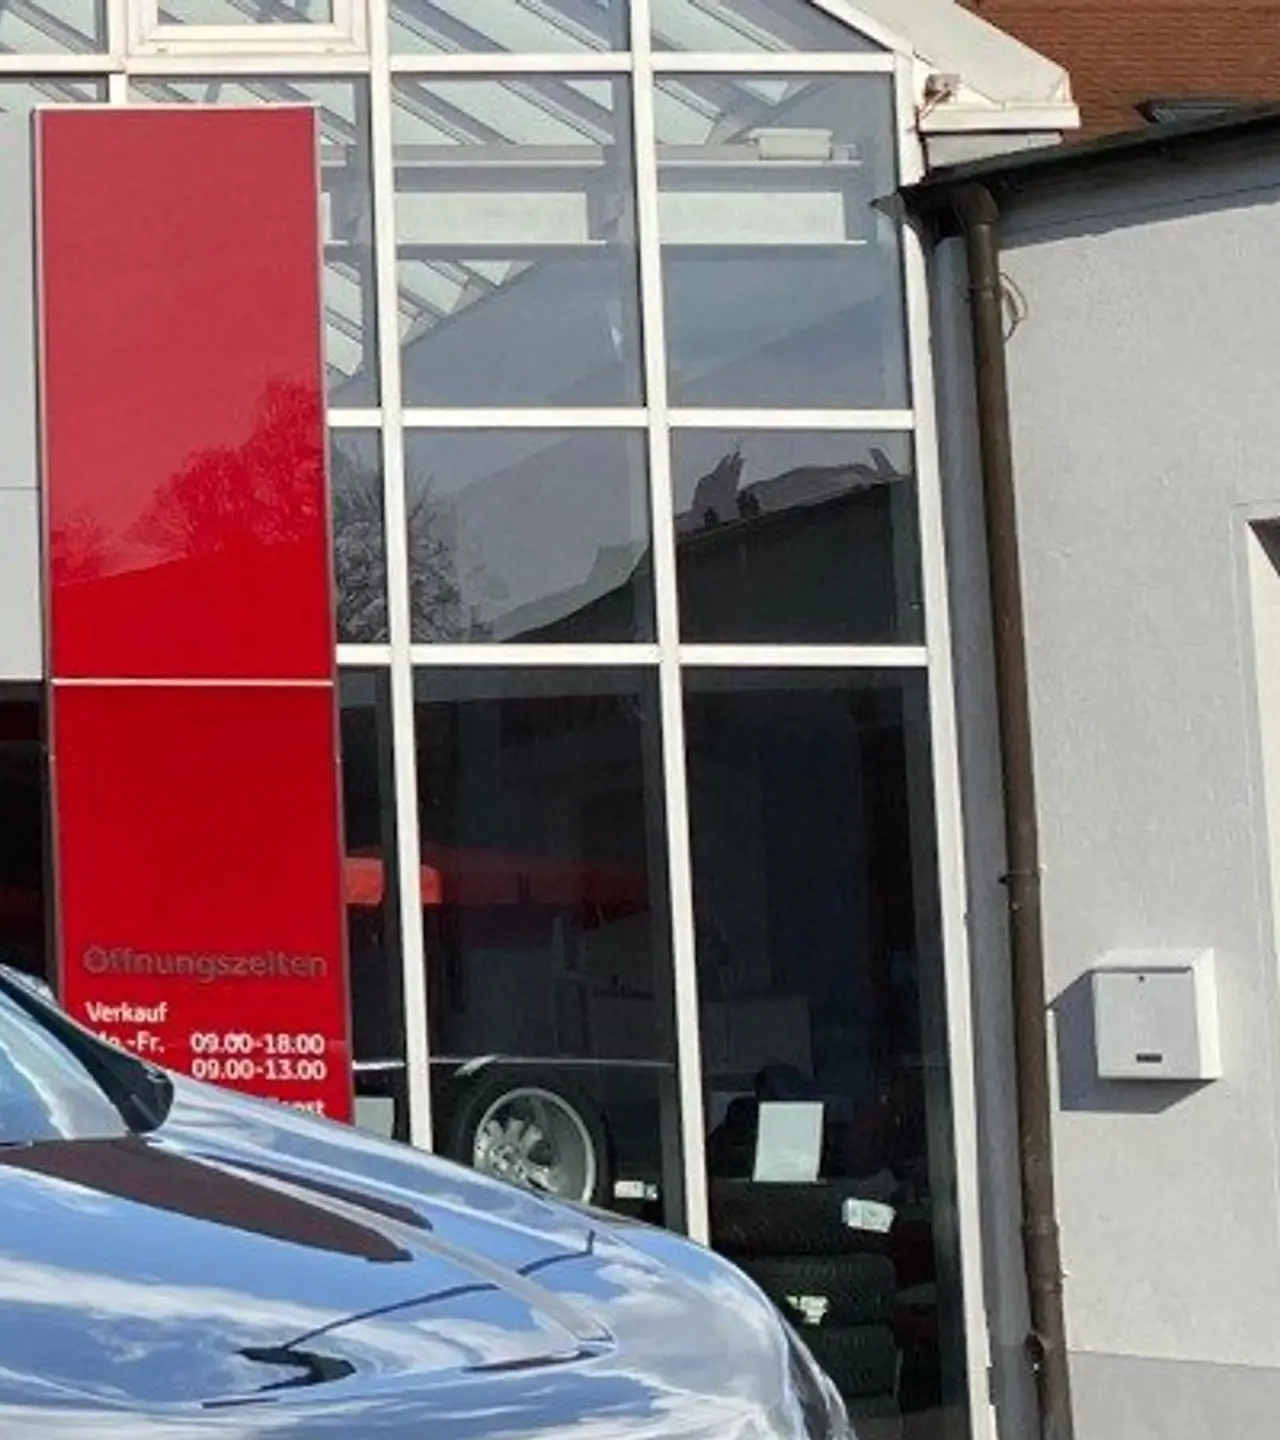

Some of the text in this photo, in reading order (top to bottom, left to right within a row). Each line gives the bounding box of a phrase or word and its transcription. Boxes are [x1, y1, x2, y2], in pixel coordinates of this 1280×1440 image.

[83, 944, 328, 982] Öffnungszeiten
[84, 1001, 168, 1023] Verkauf
[191, 1057, 327, 1080] 09.00-13.00
